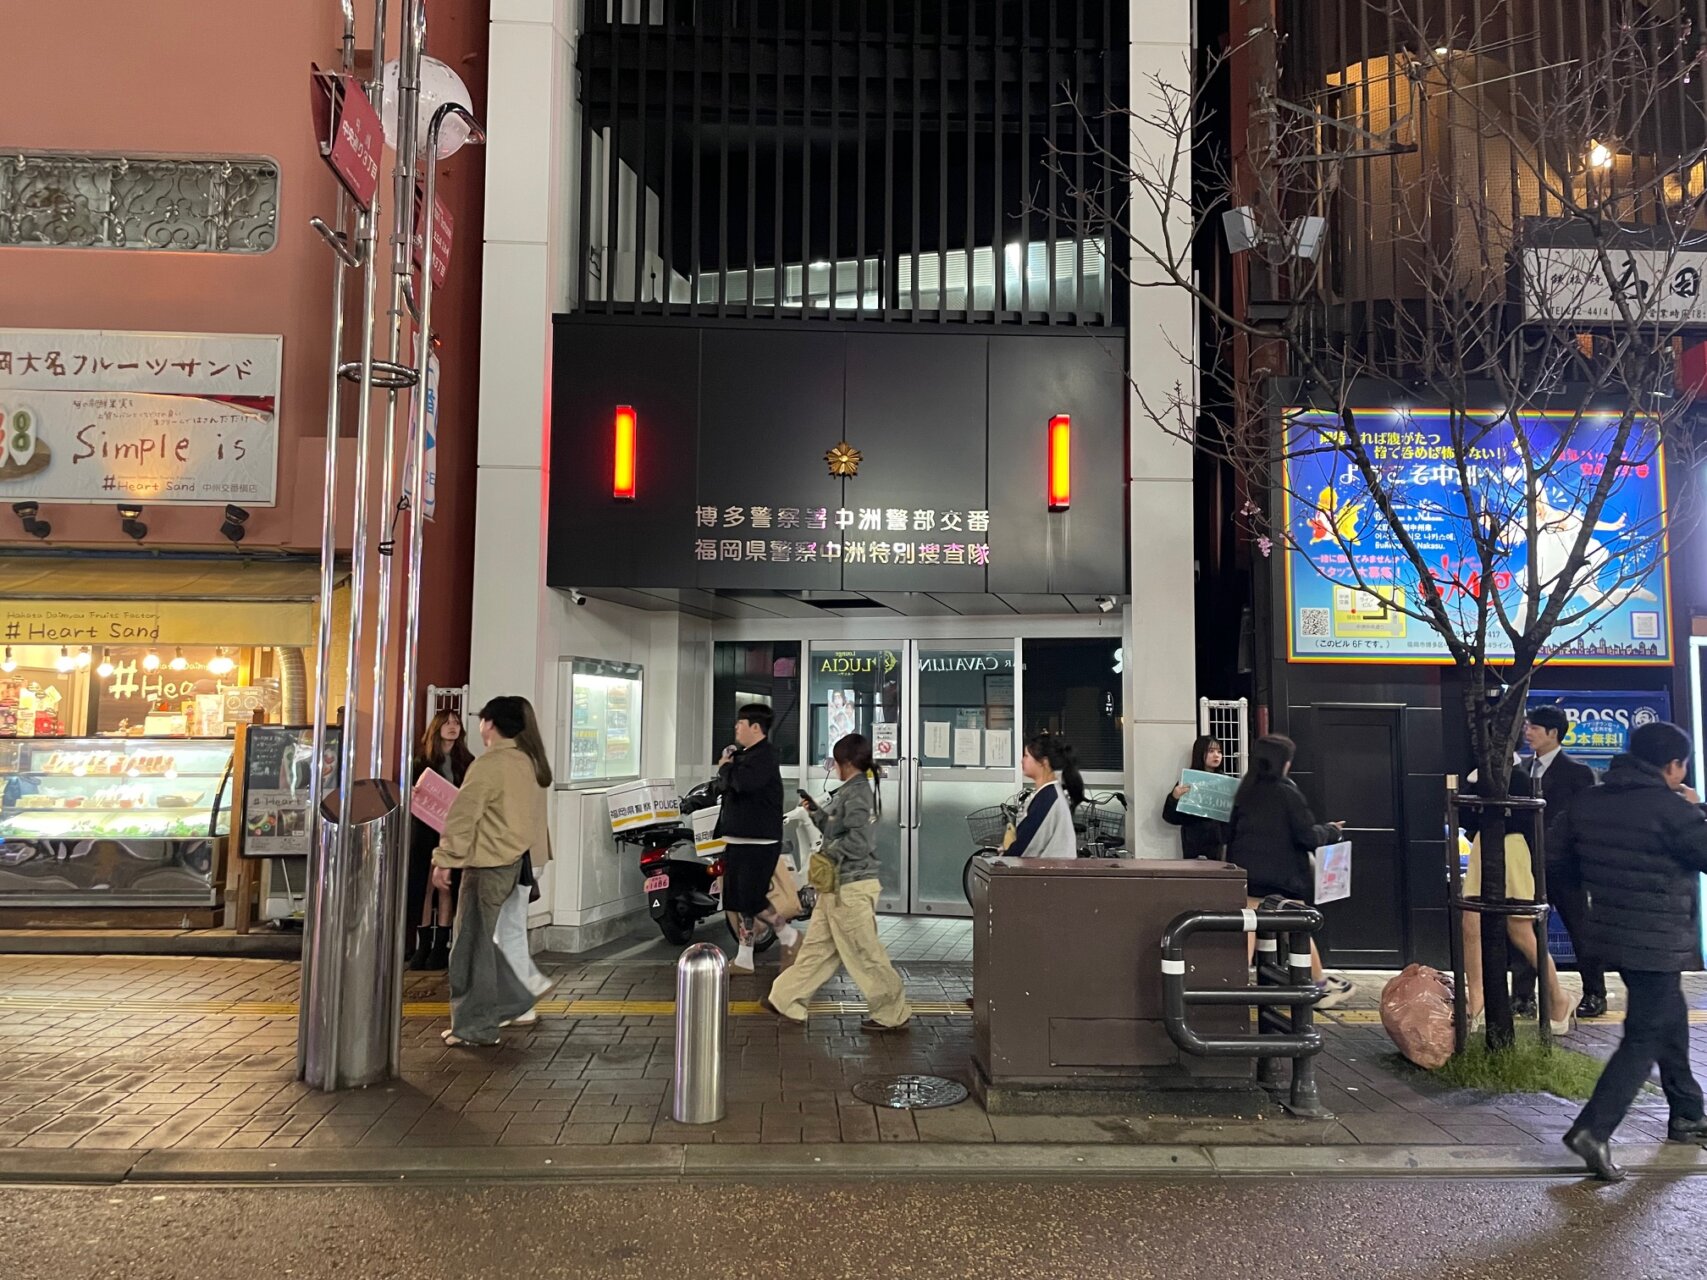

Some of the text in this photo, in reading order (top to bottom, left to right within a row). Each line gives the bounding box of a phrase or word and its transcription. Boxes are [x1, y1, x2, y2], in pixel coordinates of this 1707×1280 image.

[72, 423, 247, 466] Simple is
[165, 482, 196, 492] Sand
[695, 505, 991, 532] 博多警察署中洲警部交番
[694, 538, 990, 565] 福岡県警察中洲特別捜査隊
[89, 611, 119, 619] Fruits
[123, 611, 161, 620] Factory
[109, 622, 160, 639] Sand
[1563, 707, 1630, 730] BOSS
[654, 799, 679, 810] POLICE
